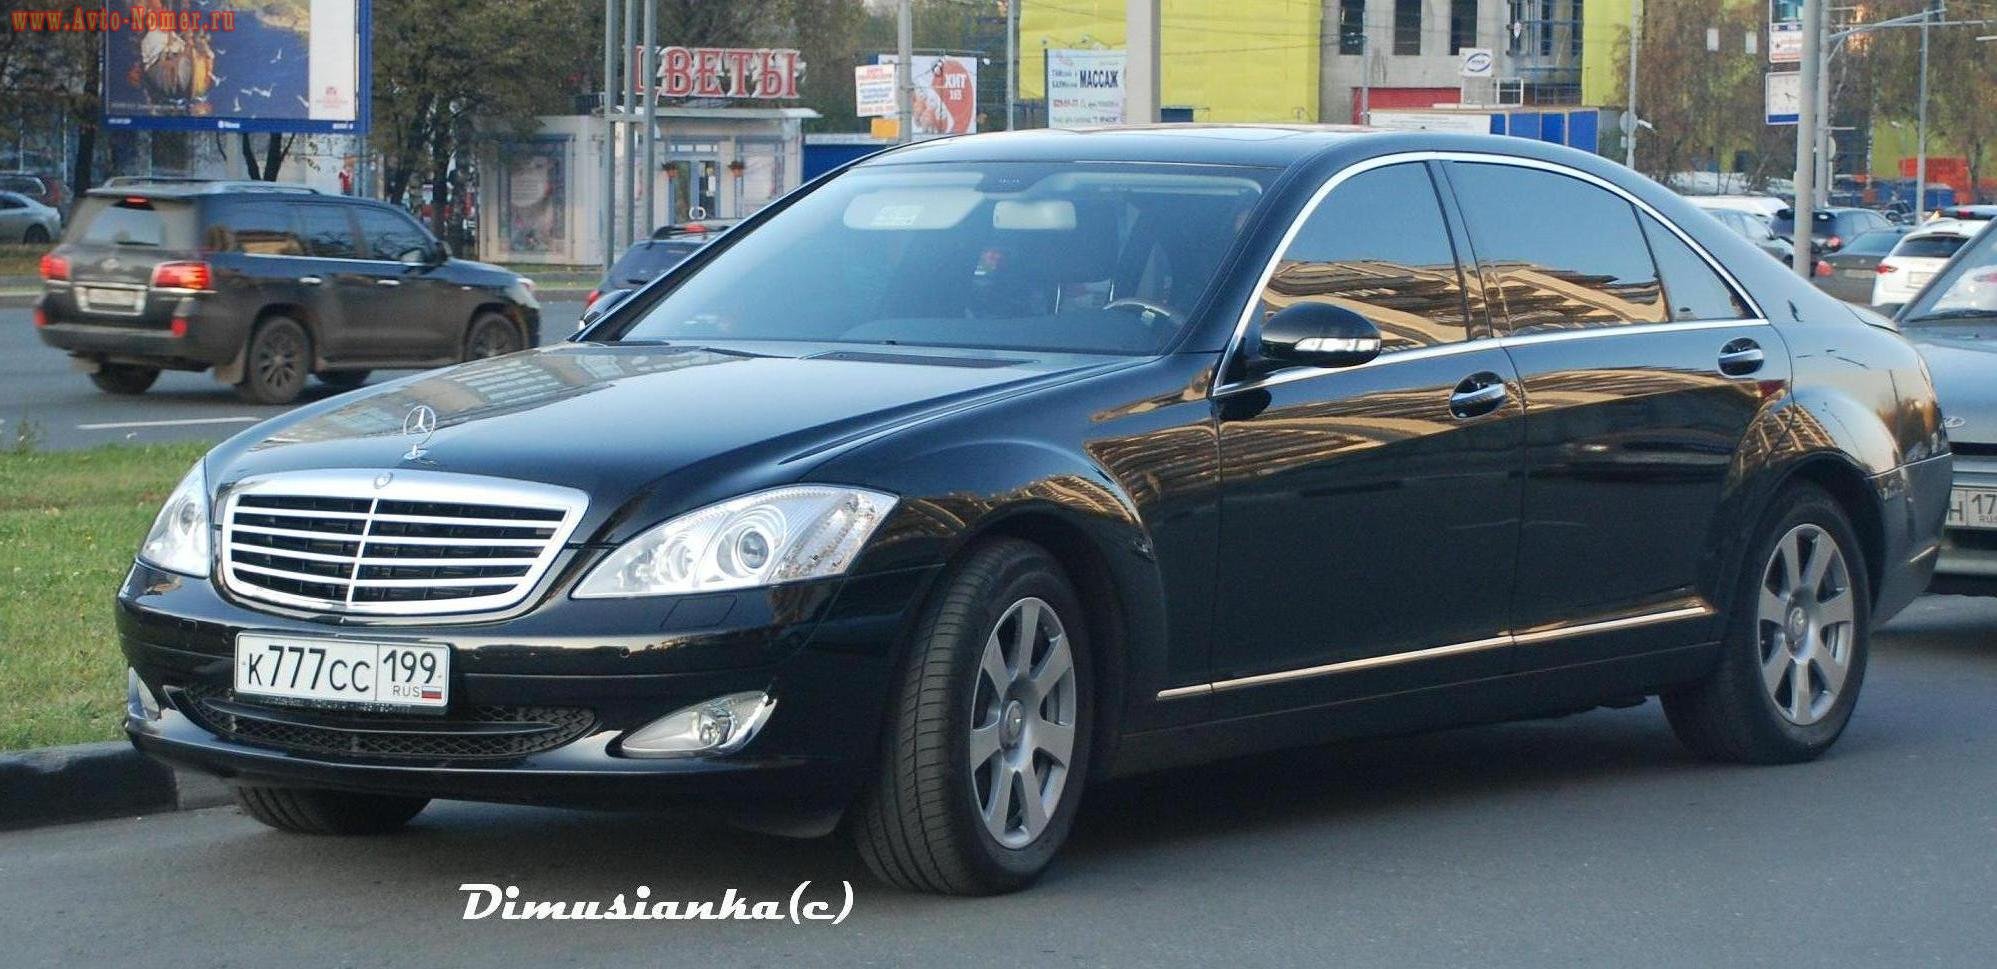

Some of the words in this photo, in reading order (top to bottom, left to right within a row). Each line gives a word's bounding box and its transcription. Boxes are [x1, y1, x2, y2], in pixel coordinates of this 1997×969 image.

[1079, 69, 1119, 89] МАССАЖ
[382, 649, 437, 684] 199
[392, 684, 420, 698] RUS
